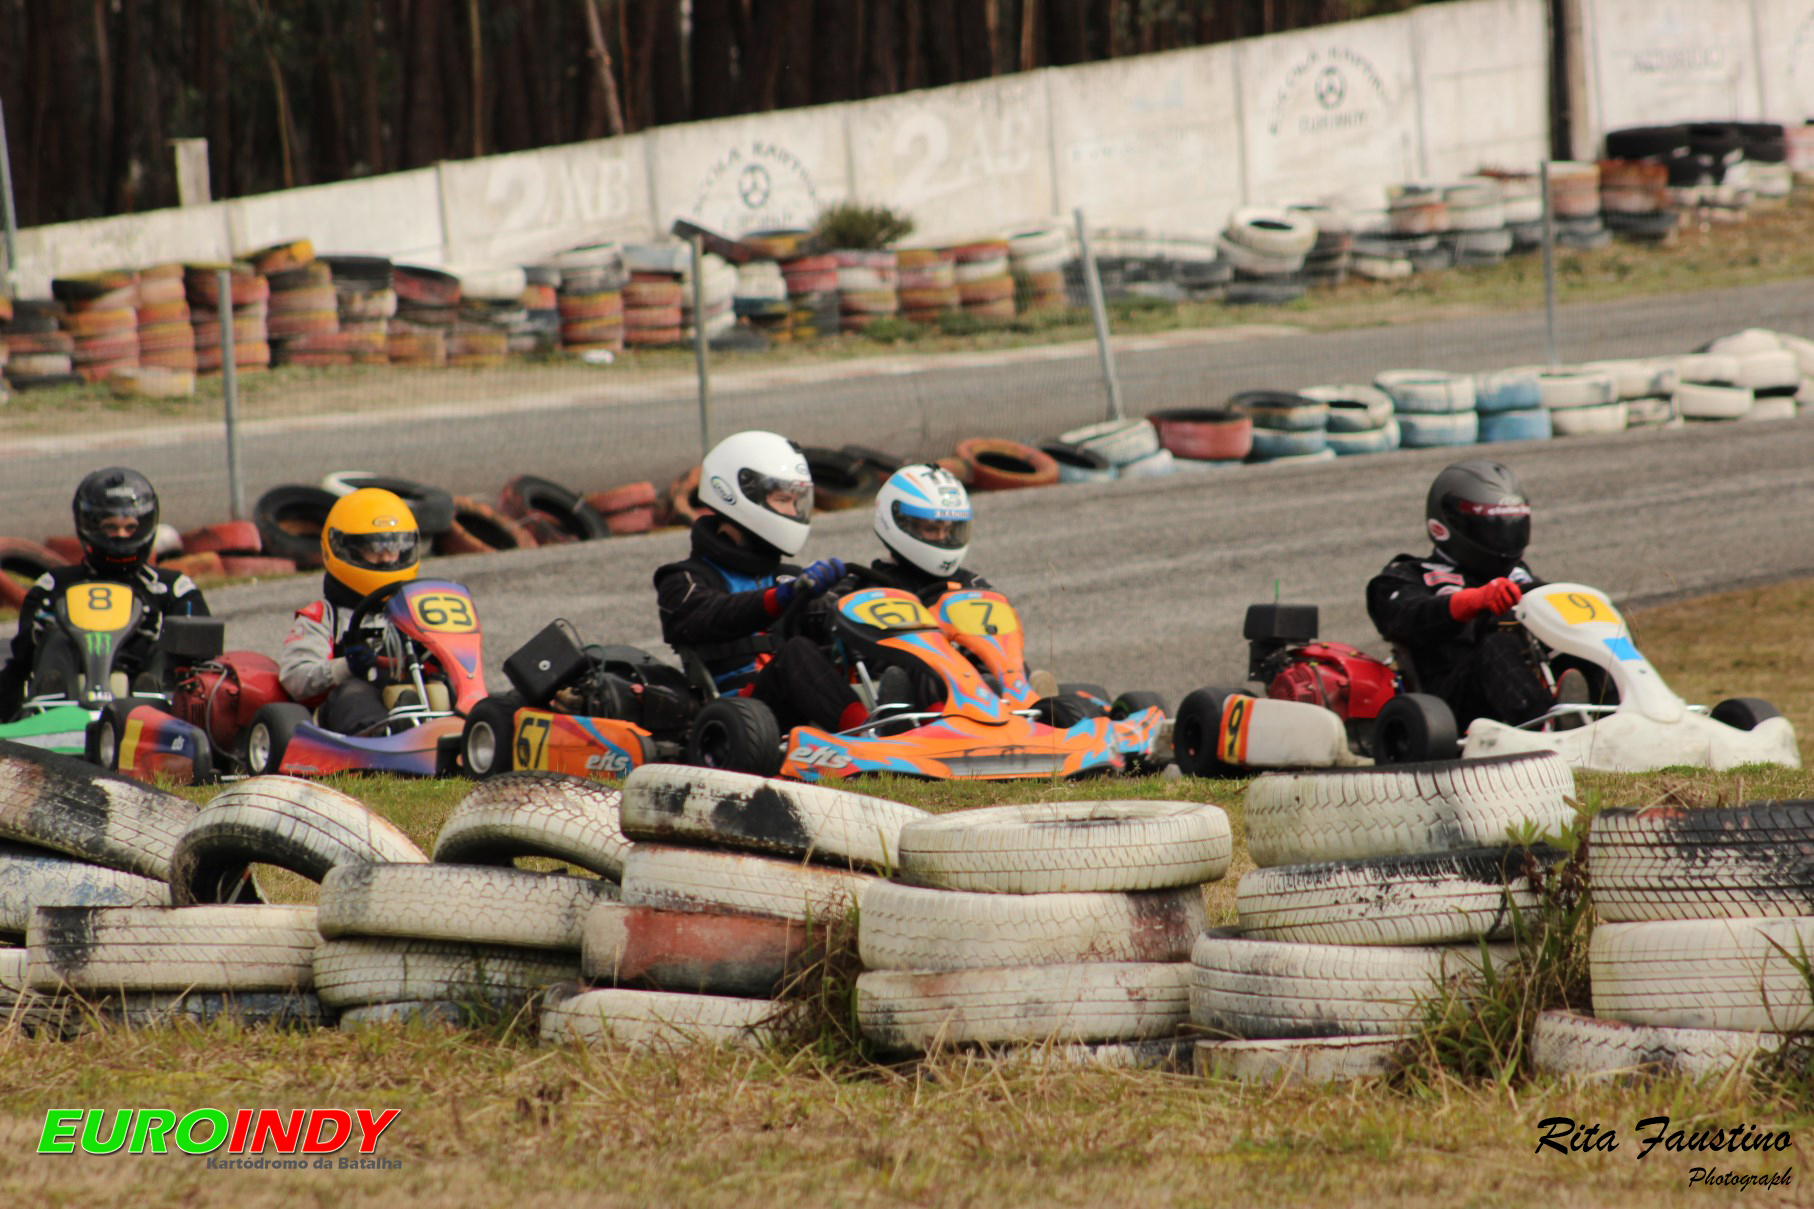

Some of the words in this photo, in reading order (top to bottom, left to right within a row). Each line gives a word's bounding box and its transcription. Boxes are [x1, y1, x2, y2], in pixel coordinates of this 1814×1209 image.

[88, 587, 112, 610] 8
[418, 596, 472, 626] 63
[1567, 593, 1596, 620] 9
[869, 601, 920, 628] 67
[1228, 699, 1244, 757] 9
[516, 716, 551, 769] 67
